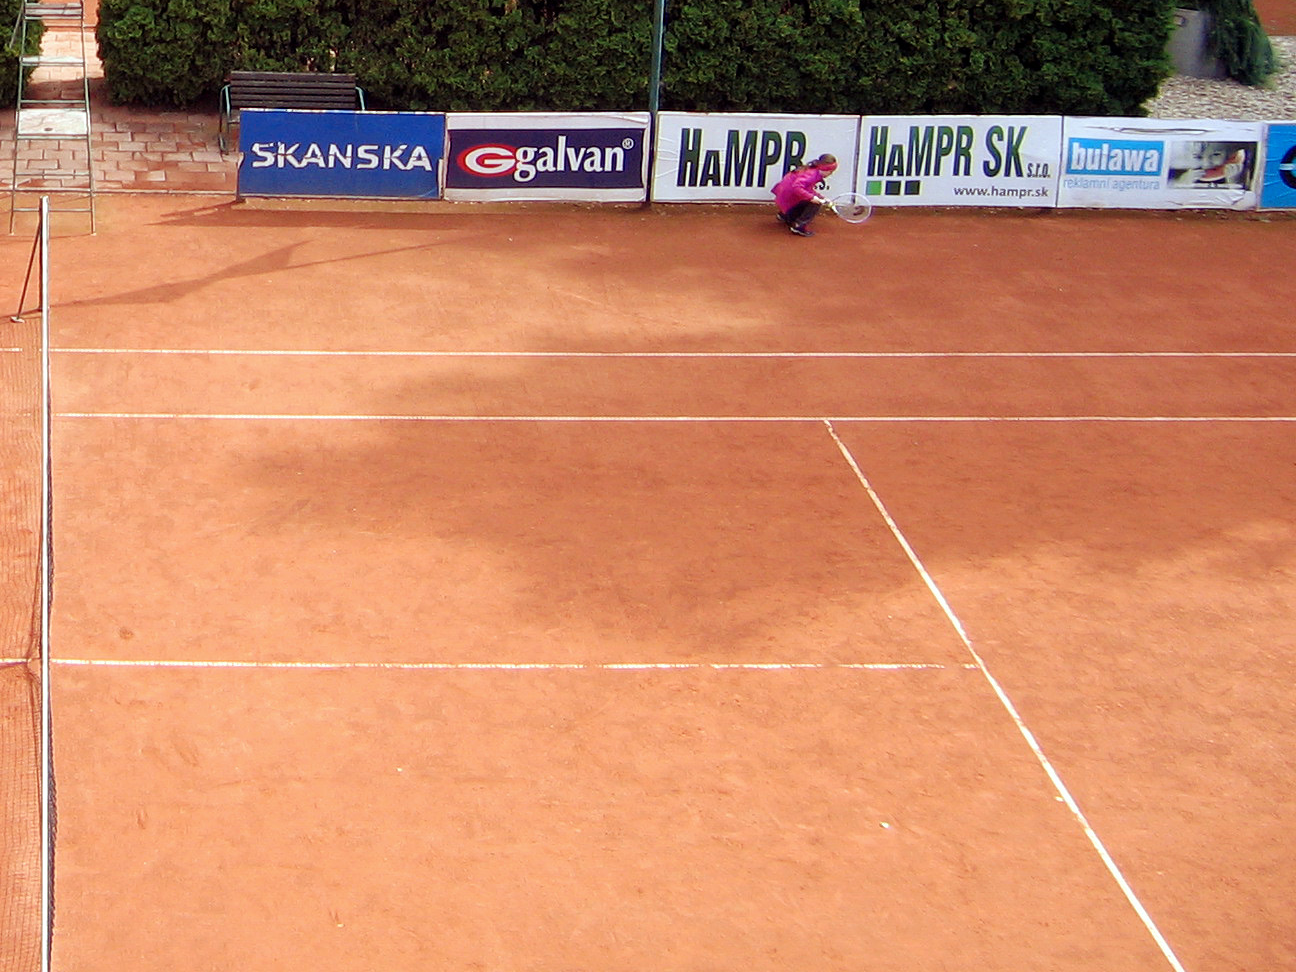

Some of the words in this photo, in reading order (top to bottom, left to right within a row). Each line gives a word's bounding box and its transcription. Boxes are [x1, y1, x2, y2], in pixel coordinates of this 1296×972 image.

[251, 141, 433, 172] SKANSKA
[982, 125, 1029, 178] SK
[1027, 162, 1052, 178] s.r.o.
[1070, 142, 1160, 173] bulawa
[952, 185, 1049, 199] www.hampr.sk
[1112, 180, 1160, 191] agentura
